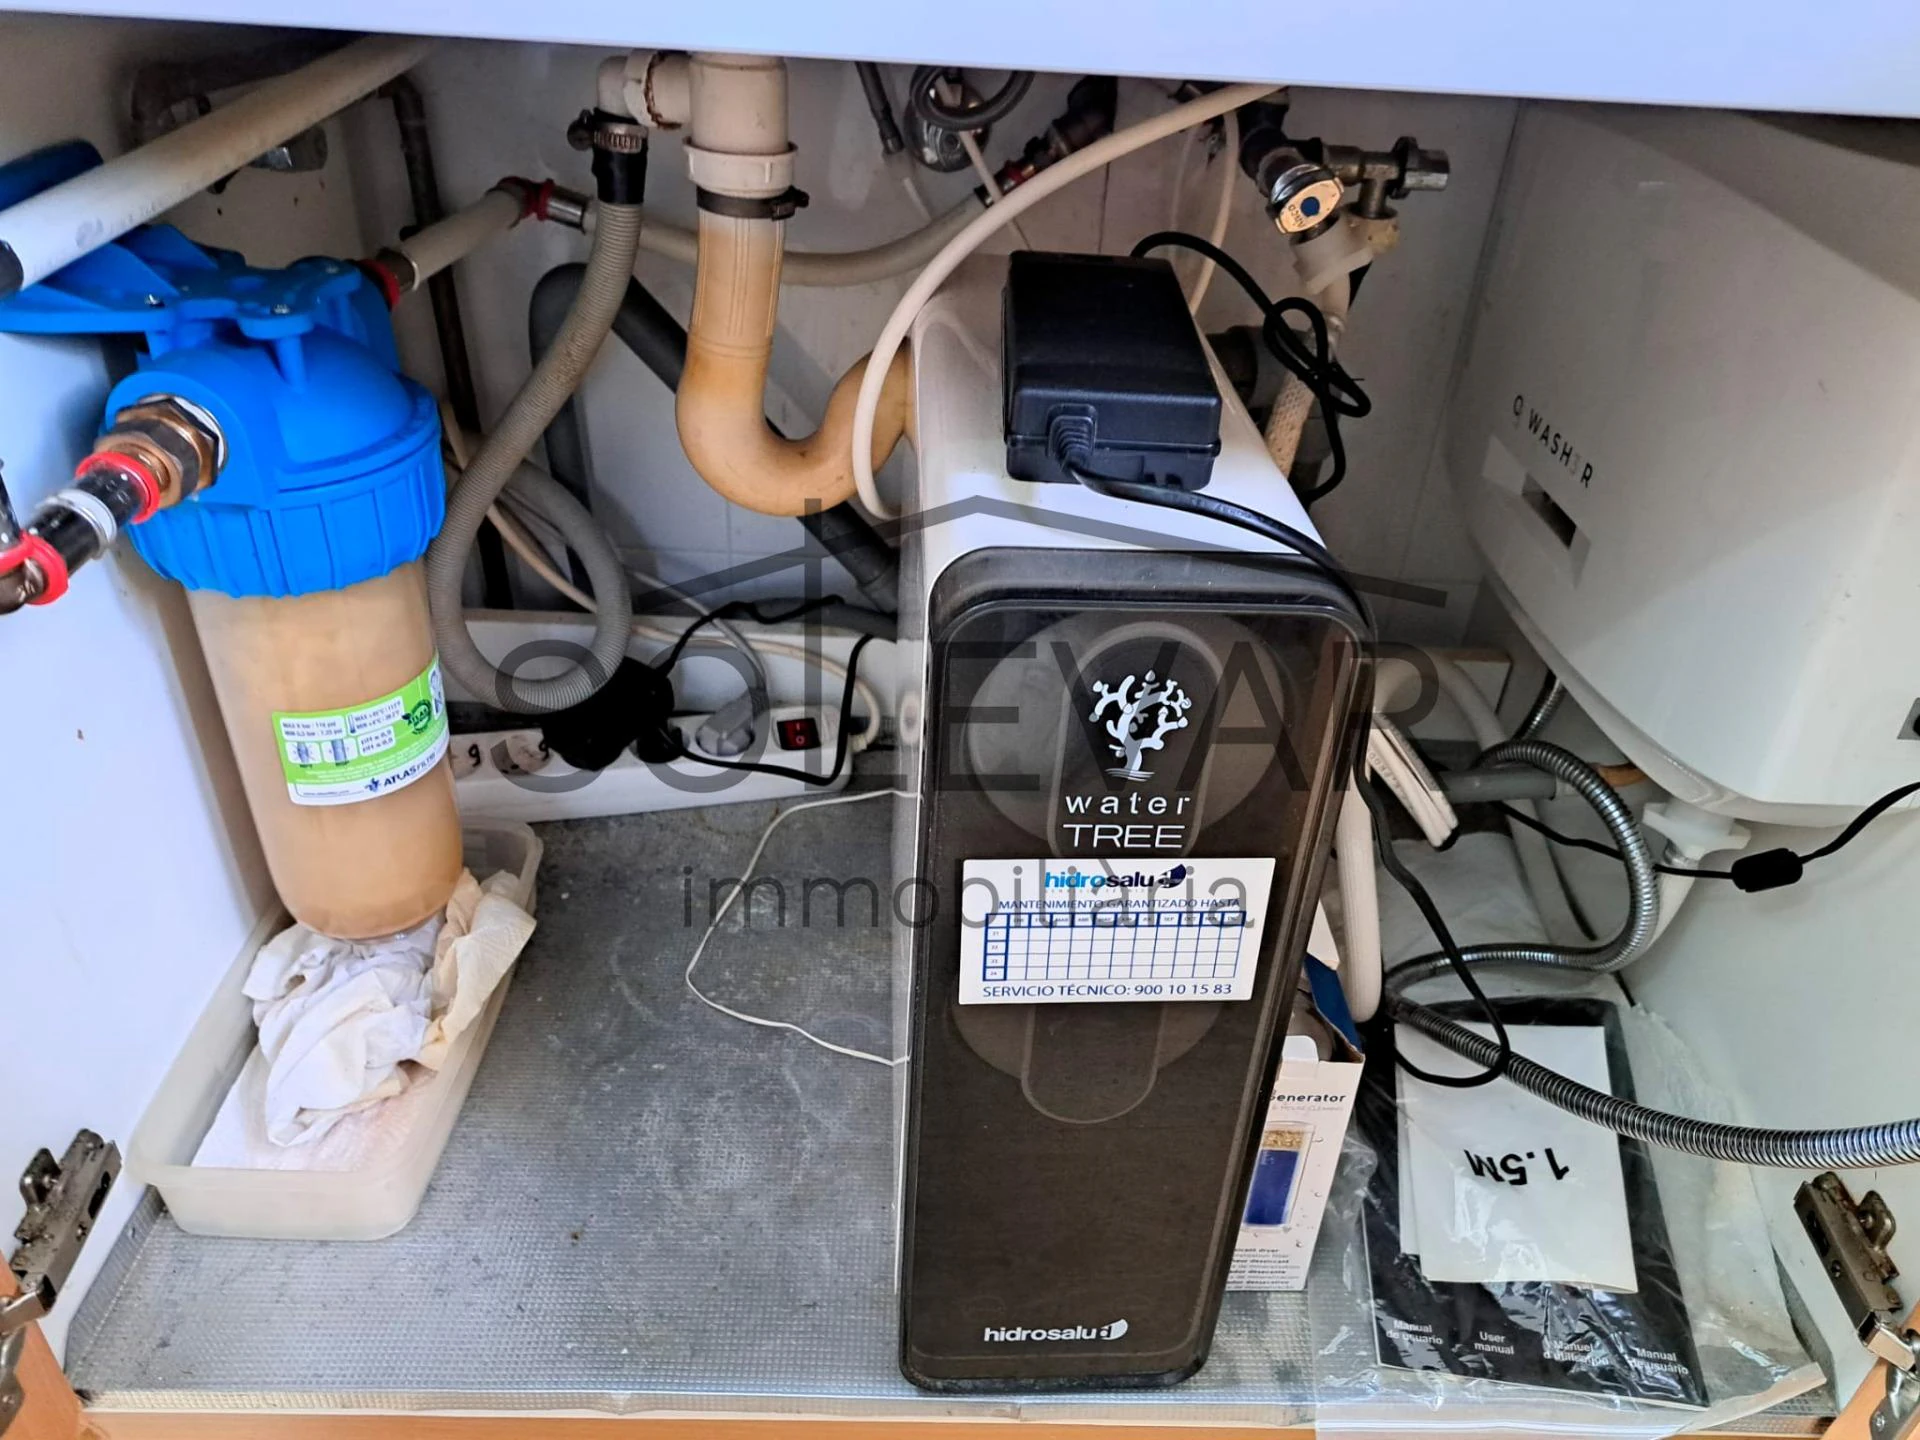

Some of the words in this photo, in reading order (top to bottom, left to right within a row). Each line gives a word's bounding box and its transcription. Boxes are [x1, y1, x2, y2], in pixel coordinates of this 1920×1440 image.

[1528, 407, 1594, 489] WASHR
[1065, 791, 1191, 815] water
[1062, 823, 1186, 848] TREE
[999, 898, 1105, 910] MANTENIMIENTO
[1106, 898, 1198, 910] GARANTIZADO
[1200, 898, 1240, 909] HASTA
[982, 985, 1054, 998] SERVICIO
[1059, 983, 1131, 997] TÉCNICO:
[1134, 984, 1162, 996] 900
[1168, 984, 1187, 996] 10
[1193, 984, 1209, 995] 15
[1213, 983, 1232, 995] 83
[1463, 1147, 1570, 1186] 1.5M
[1393, 1319, 1433, 1333] Manual
[1479, 1331, 1506, 1343] User
[1474, 1341, 1515, 1355] manual
[1636, 1349, 1677, 1361] Manual
